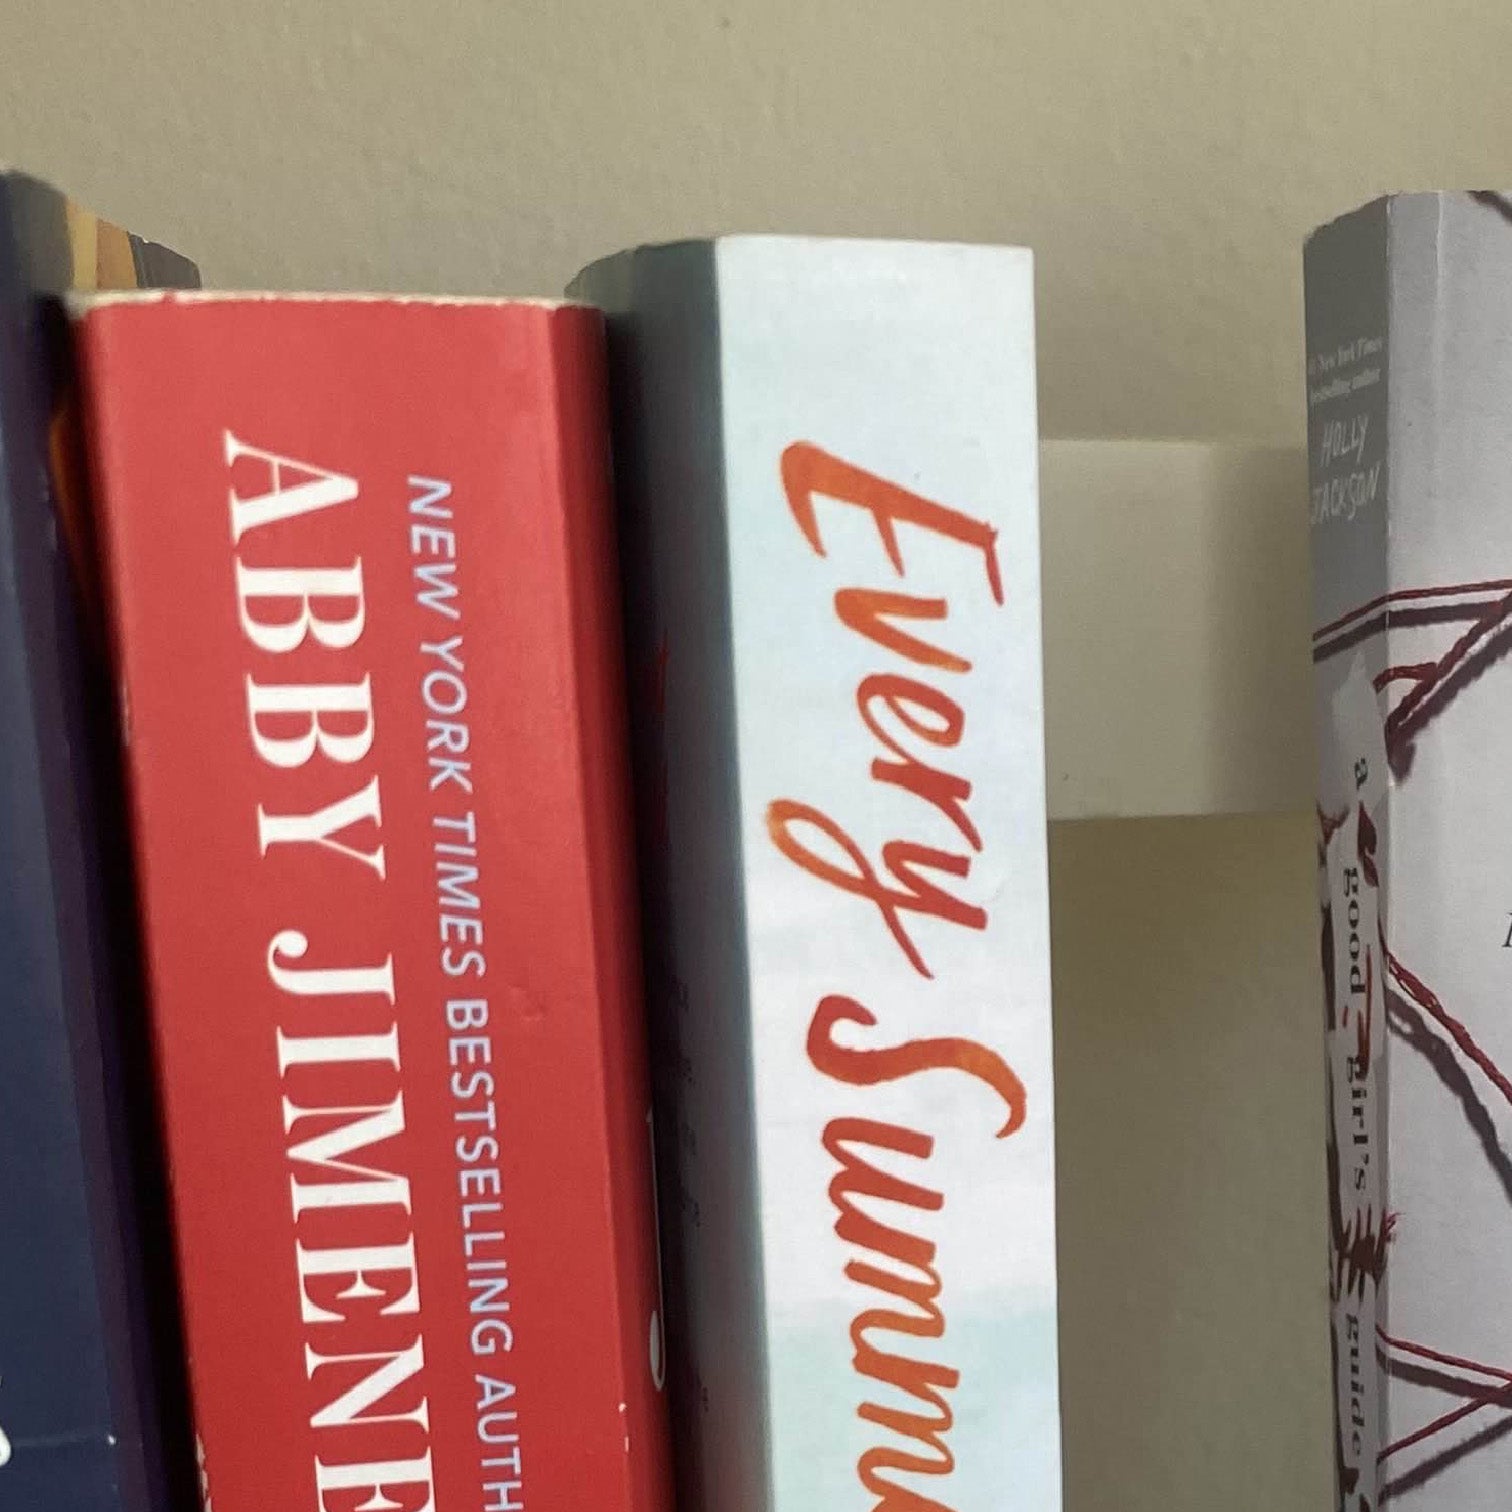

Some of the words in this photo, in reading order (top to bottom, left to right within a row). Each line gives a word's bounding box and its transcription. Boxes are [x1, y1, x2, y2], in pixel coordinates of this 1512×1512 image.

[407, 474, 461, 620] NEW
[223, 429, 386, 881] ABBY
[420, 636, 474, 793] YORK
[765, 440, 1006, 980] Every
[433, 811, 487, 978] TIMES
[1343, 867, 1365, 994] good
[446, 998, 514, 1355] BESTSELLING
